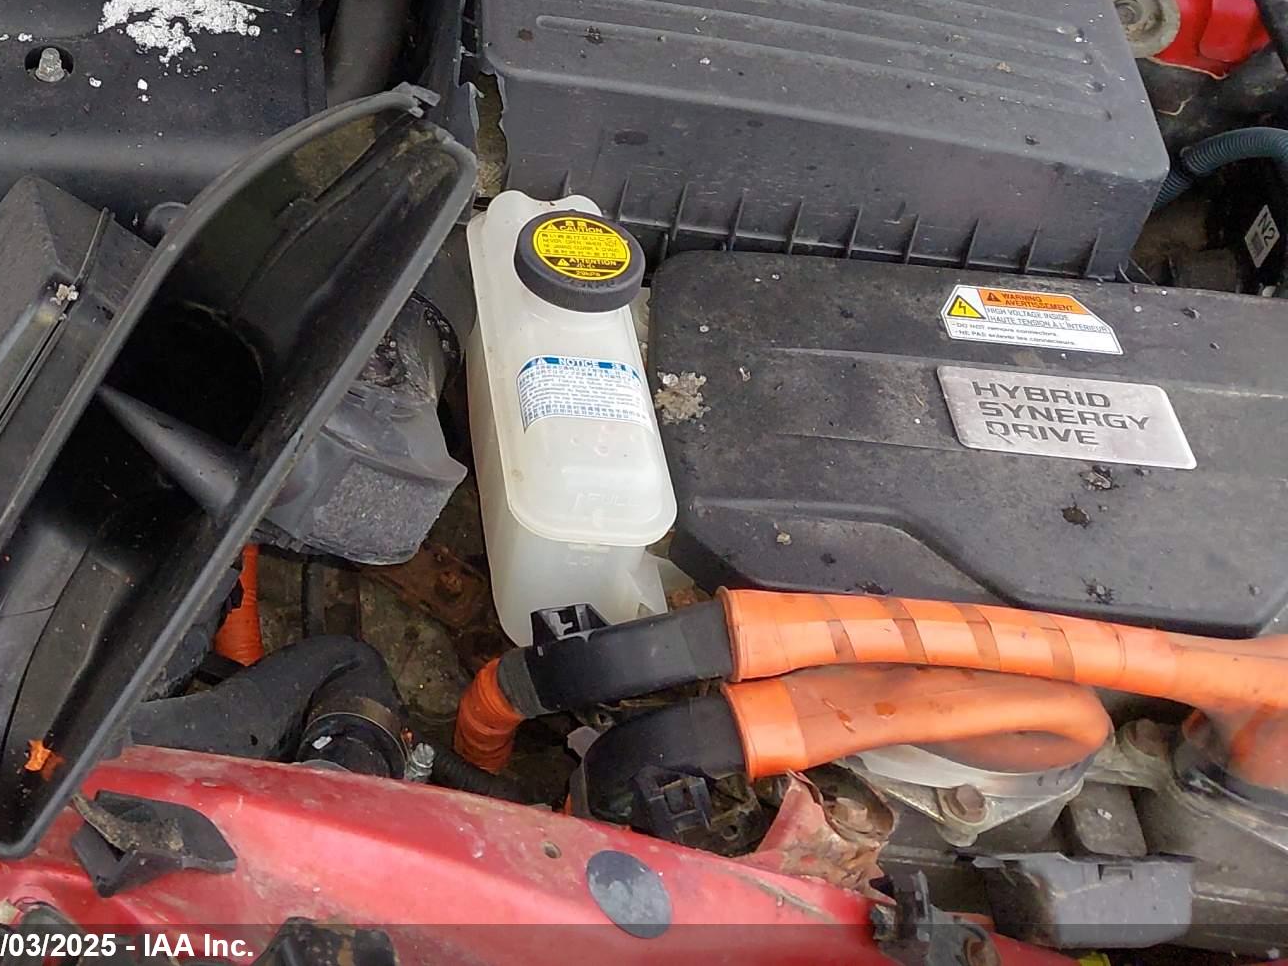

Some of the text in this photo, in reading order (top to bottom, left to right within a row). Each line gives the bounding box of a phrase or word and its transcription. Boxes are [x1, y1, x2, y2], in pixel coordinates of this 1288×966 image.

[559, 225, 603, 235] CAUTION
[569, 257, 617, 267] ATTENTION
[1001, 292, 1043, 303] WARNING
[1004, 299, 1074, 312] AVERTISSEMENT
[987, 307, 1070, 322] HIGH VOLTAGE INSIDE
[990, 315, 1015, 326] HAUTE
[1017, 318, 1052, 330] TENSION
[972, 380, 1112, 408] HYBRID
[978, 400, 1151, 430] SYNERGY
[985, 420, 1100, 445] DRIVE
